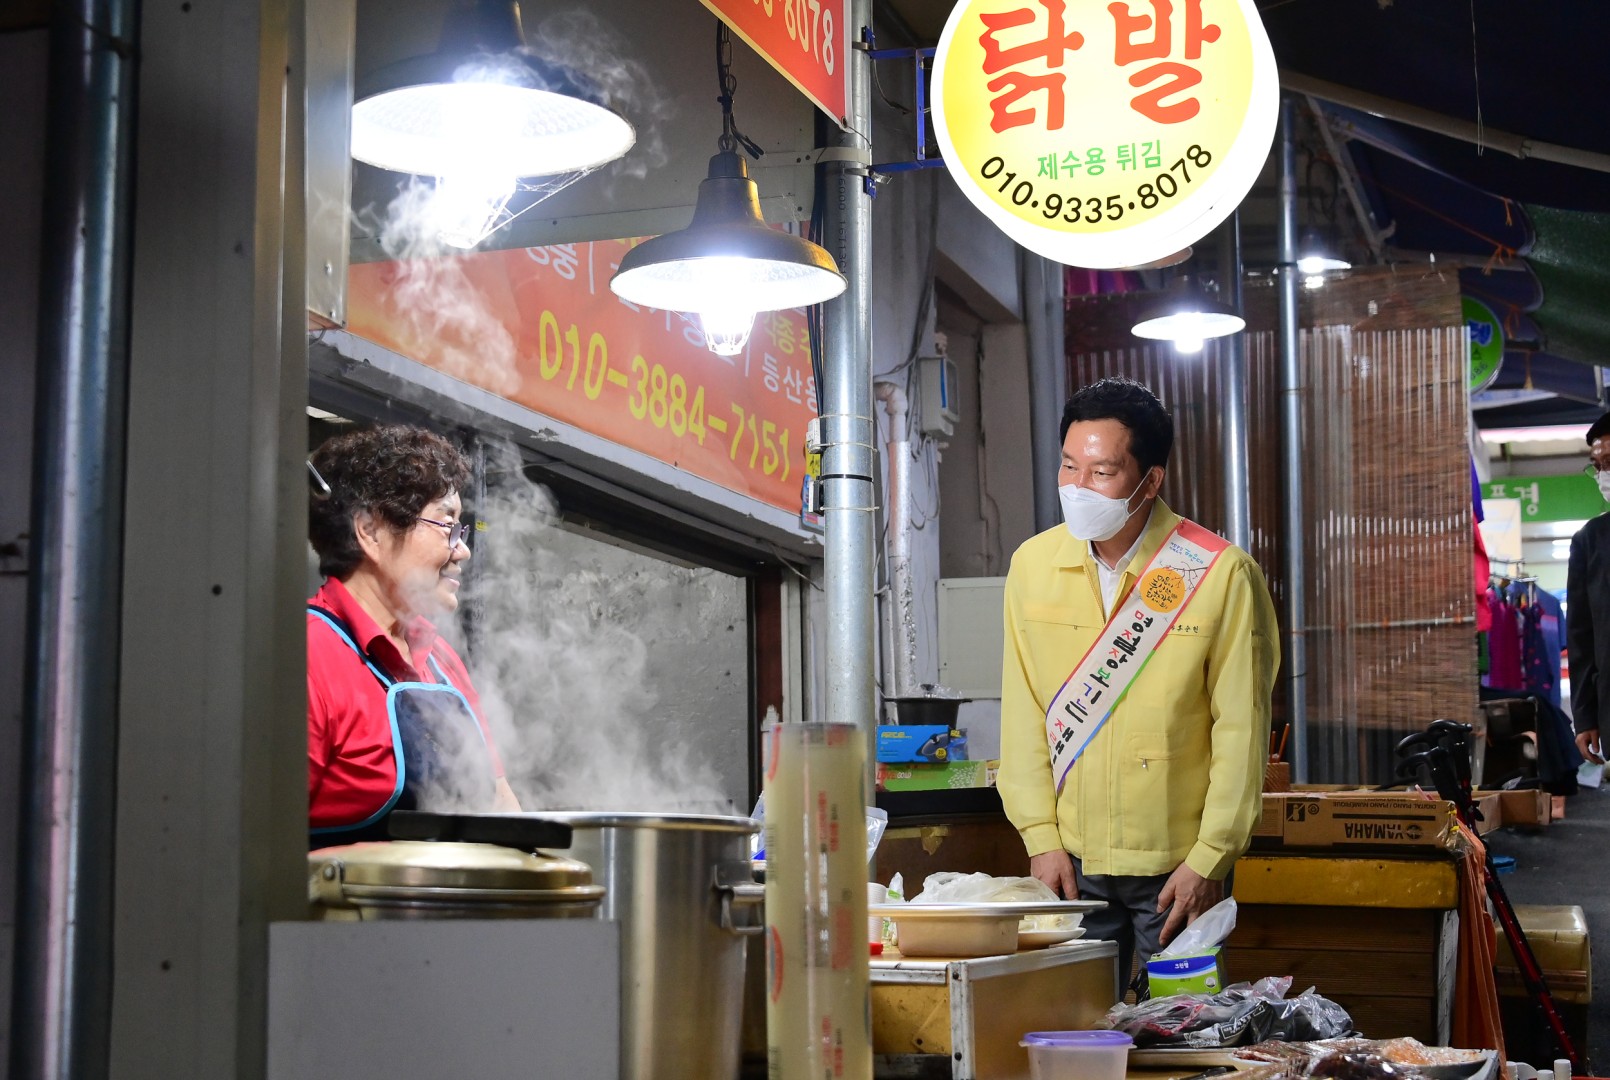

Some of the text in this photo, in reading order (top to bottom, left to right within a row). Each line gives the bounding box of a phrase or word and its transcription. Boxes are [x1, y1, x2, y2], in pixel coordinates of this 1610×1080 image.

[1036, 139, 1162, 180] 제수용 튀김
[539, 309, 790, 482] 010-3884-7151
[1344, 822, 1404, 839] YAMAHA
